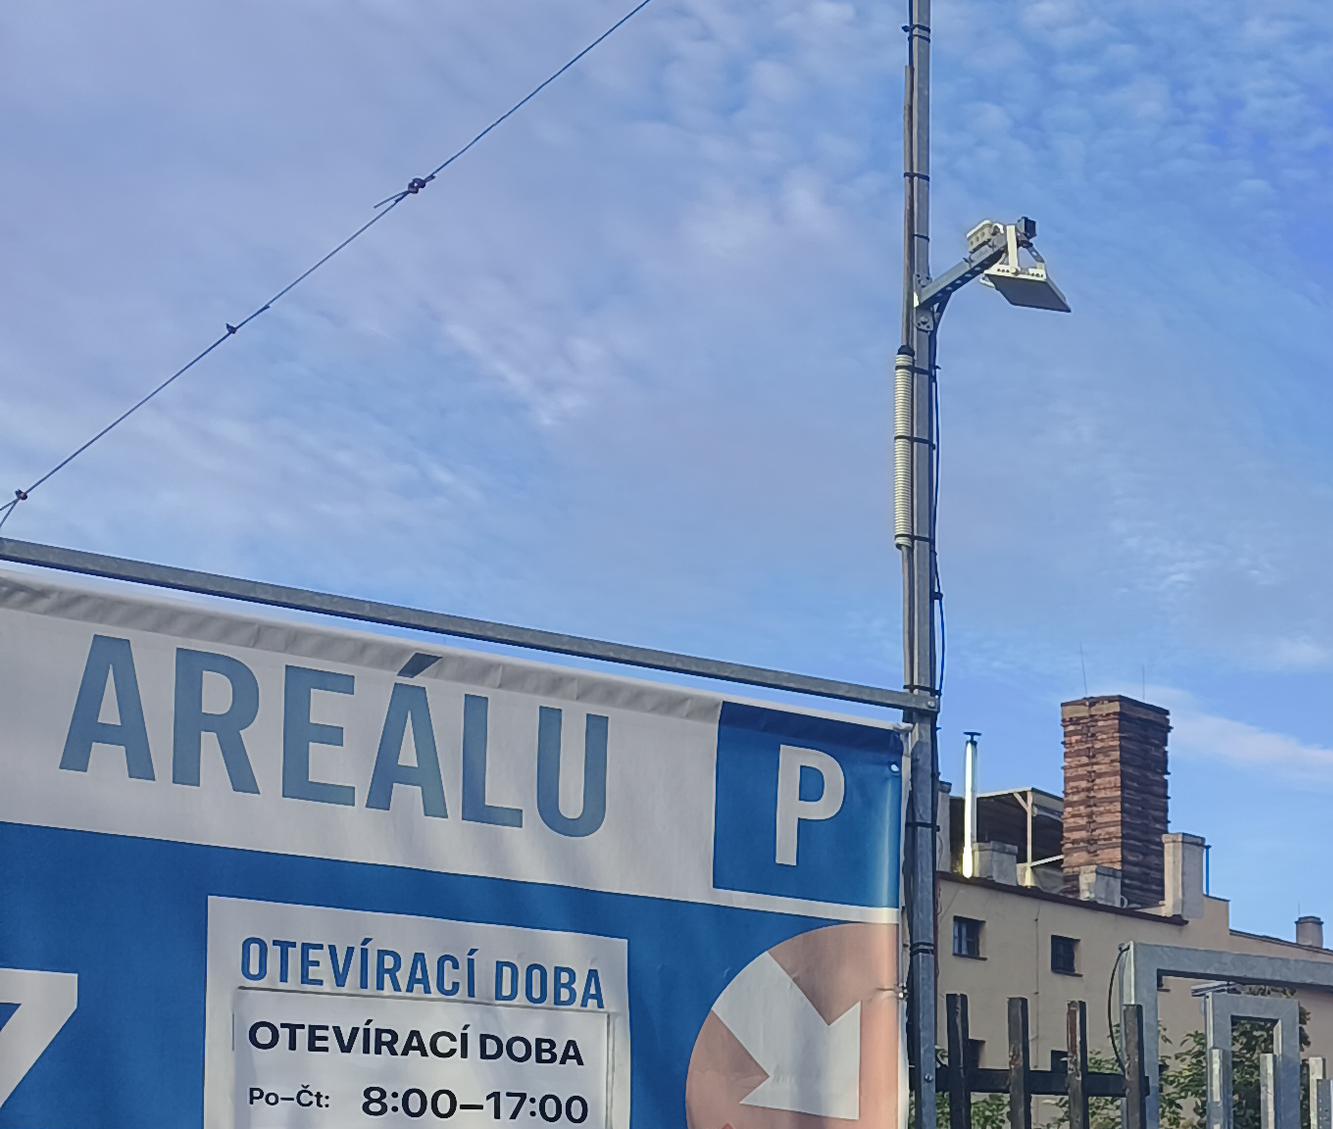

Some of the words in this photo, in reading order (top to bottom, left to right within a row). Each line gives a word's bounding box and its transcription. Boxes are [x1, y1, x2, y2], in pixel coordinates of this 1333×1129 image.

[59, 634, 609, 838] AREÁLU
[774, 744, 845, 867] P
[240, 936, 478, 998] OTEVÍRACÍ
[495, 960, 605, 1009] DOBA
[248, 1019, 470, 1060] OTEVÍRACÍ
[479, 1033, 585, 1066] DOBA
